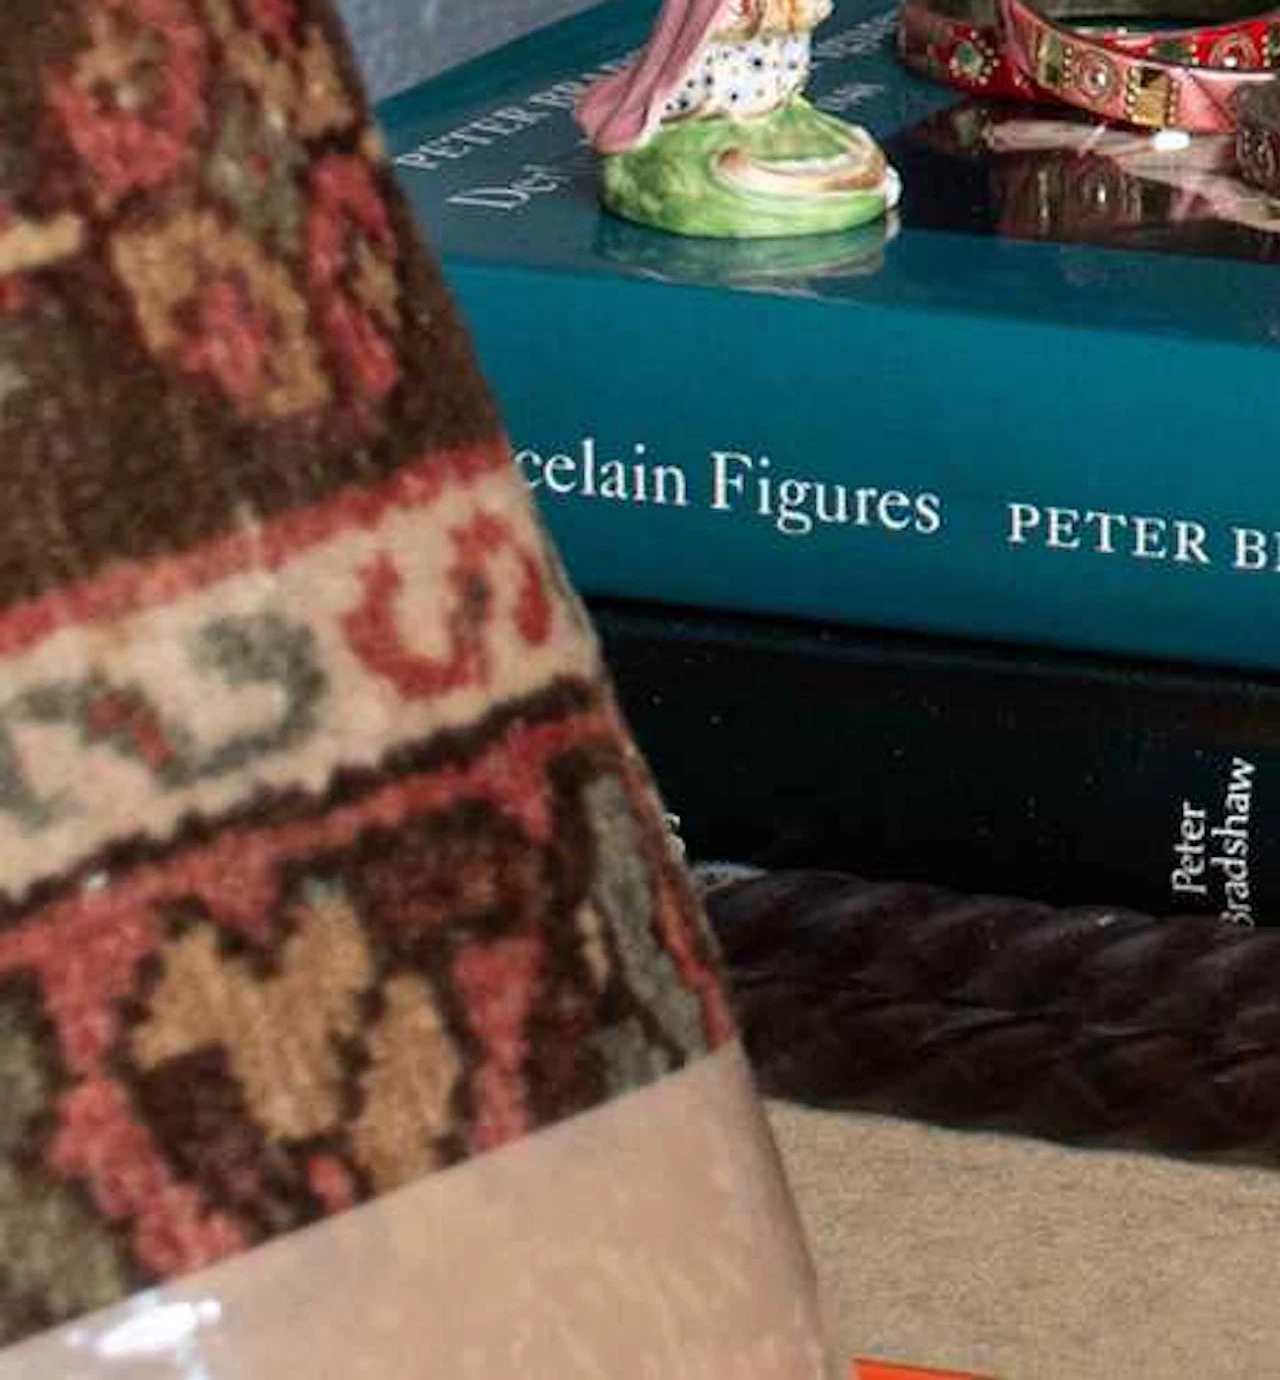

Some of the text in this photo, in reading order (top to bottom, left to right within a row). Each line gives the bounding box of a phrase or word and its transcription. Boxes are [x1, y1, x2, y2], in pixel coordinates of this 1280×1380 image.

[396, 104, 552, 170] PETER
[513, 438, 941, 535] celain Figures
[1006, 502, 1211, 564] PETER
[1171, 799, 1207, 895] Peter
